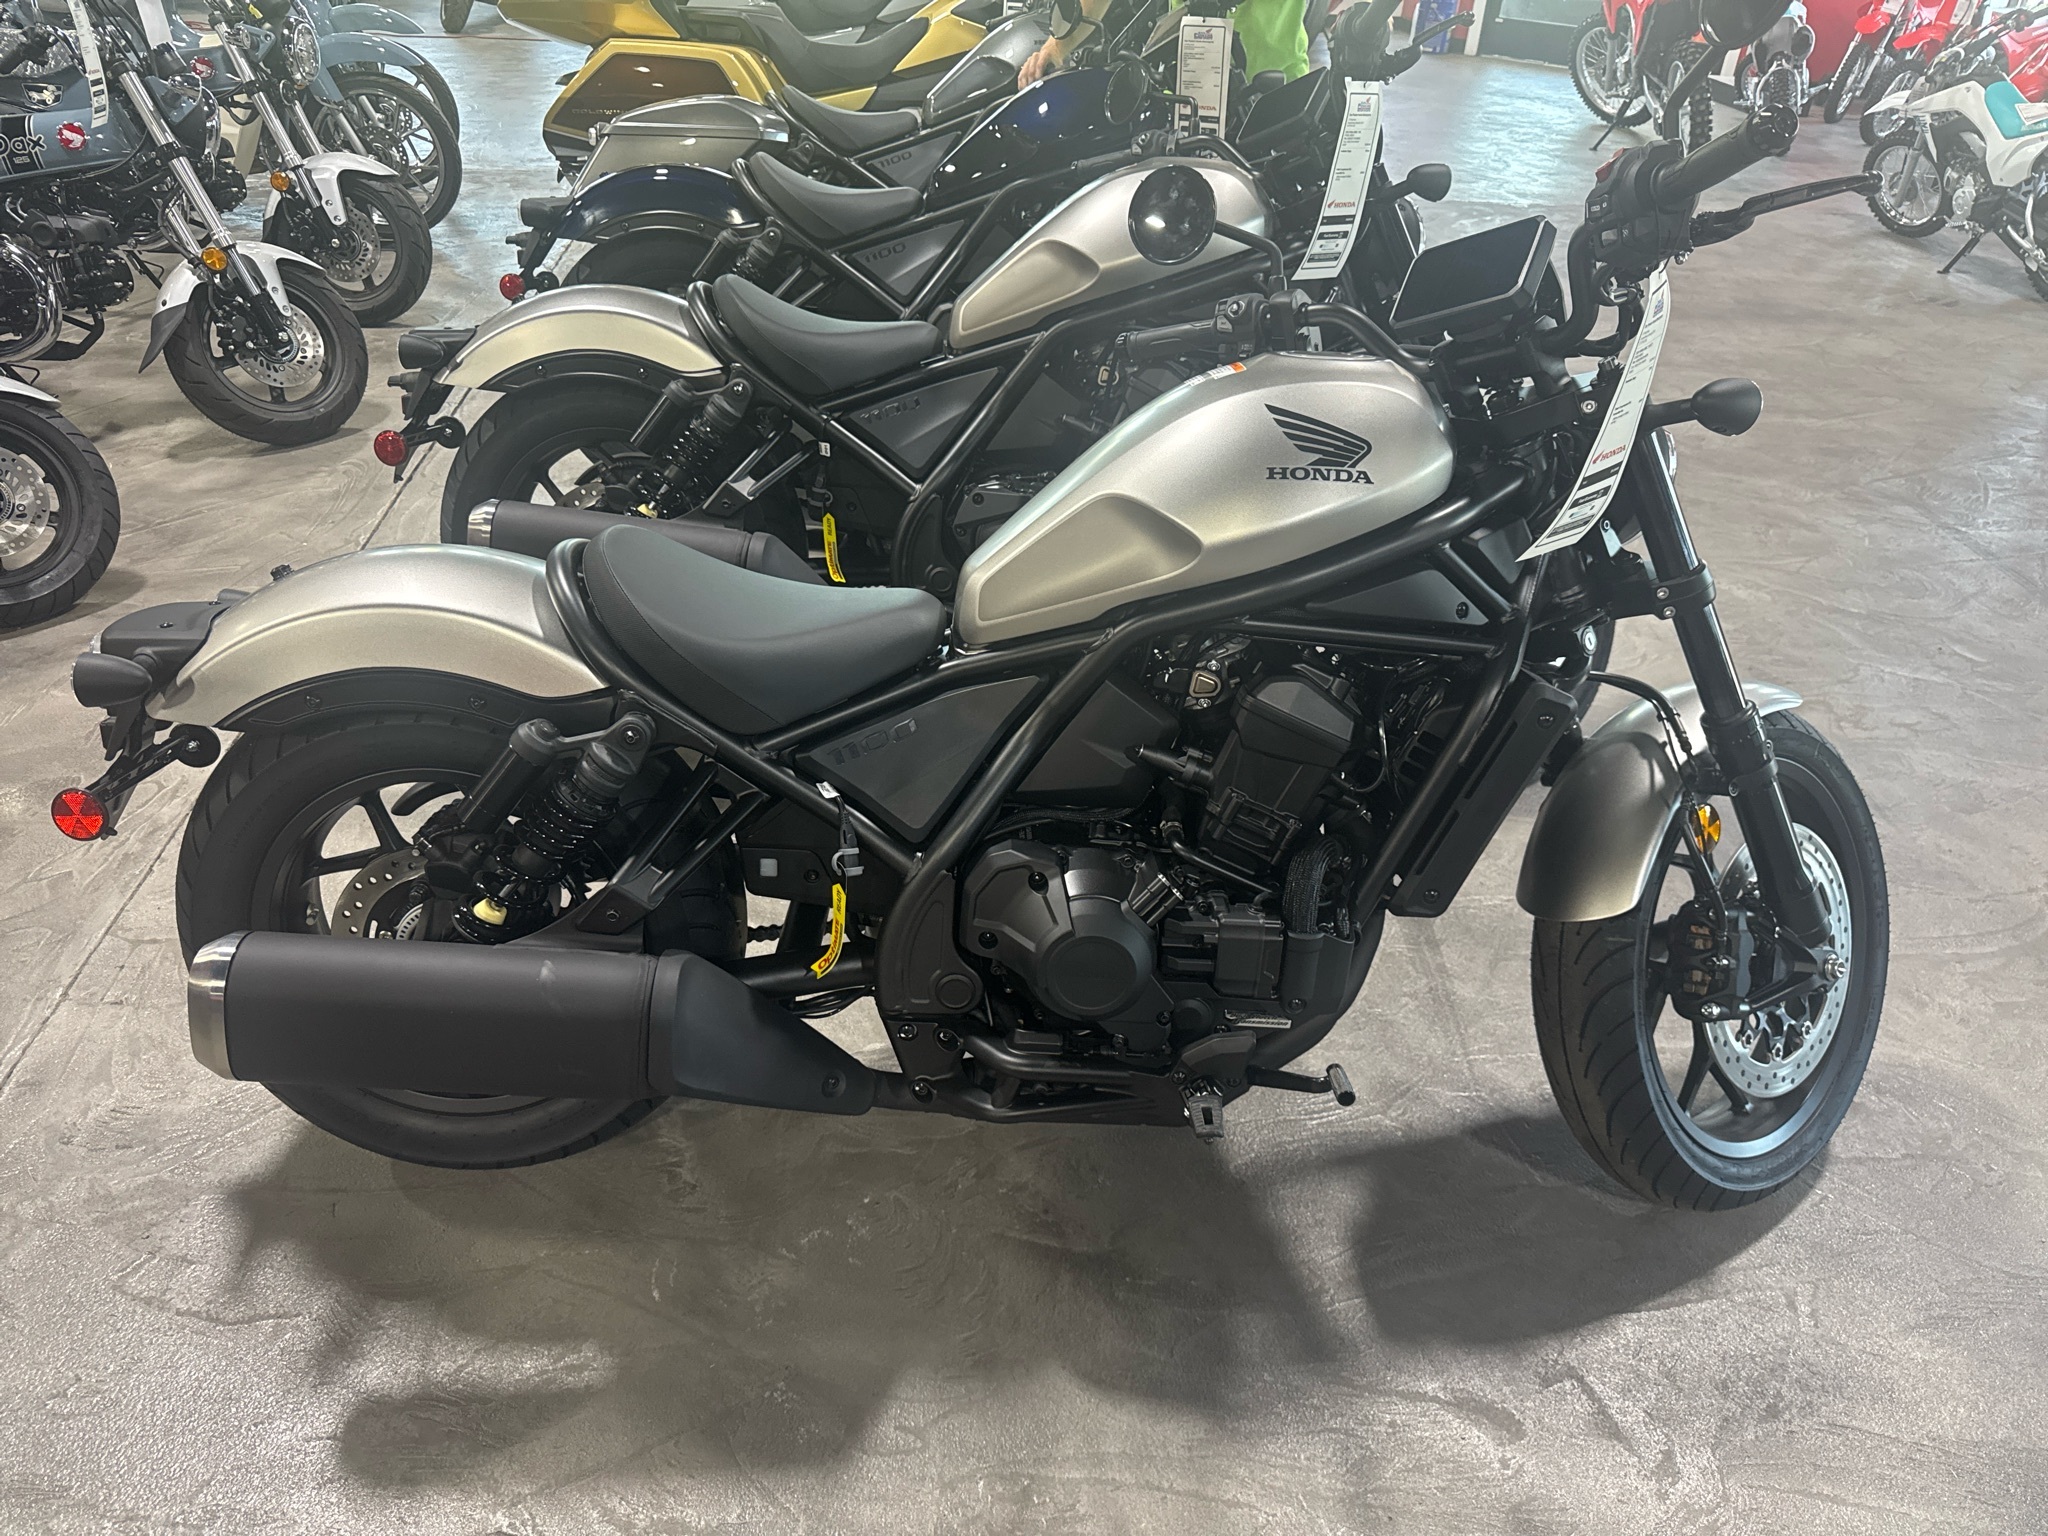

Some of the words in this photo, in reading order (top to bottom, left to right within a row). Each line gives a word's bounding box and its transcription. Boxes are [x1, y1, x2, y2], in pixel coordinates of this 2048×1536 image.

[13, 156, 30, 164] 125
[877, 151, 912, 168] 1100
[1600, 444, 1626, 462] HONDA
[1265, 466, 1375, 485] HONDA
[827, 717, 918, 766] 1100
